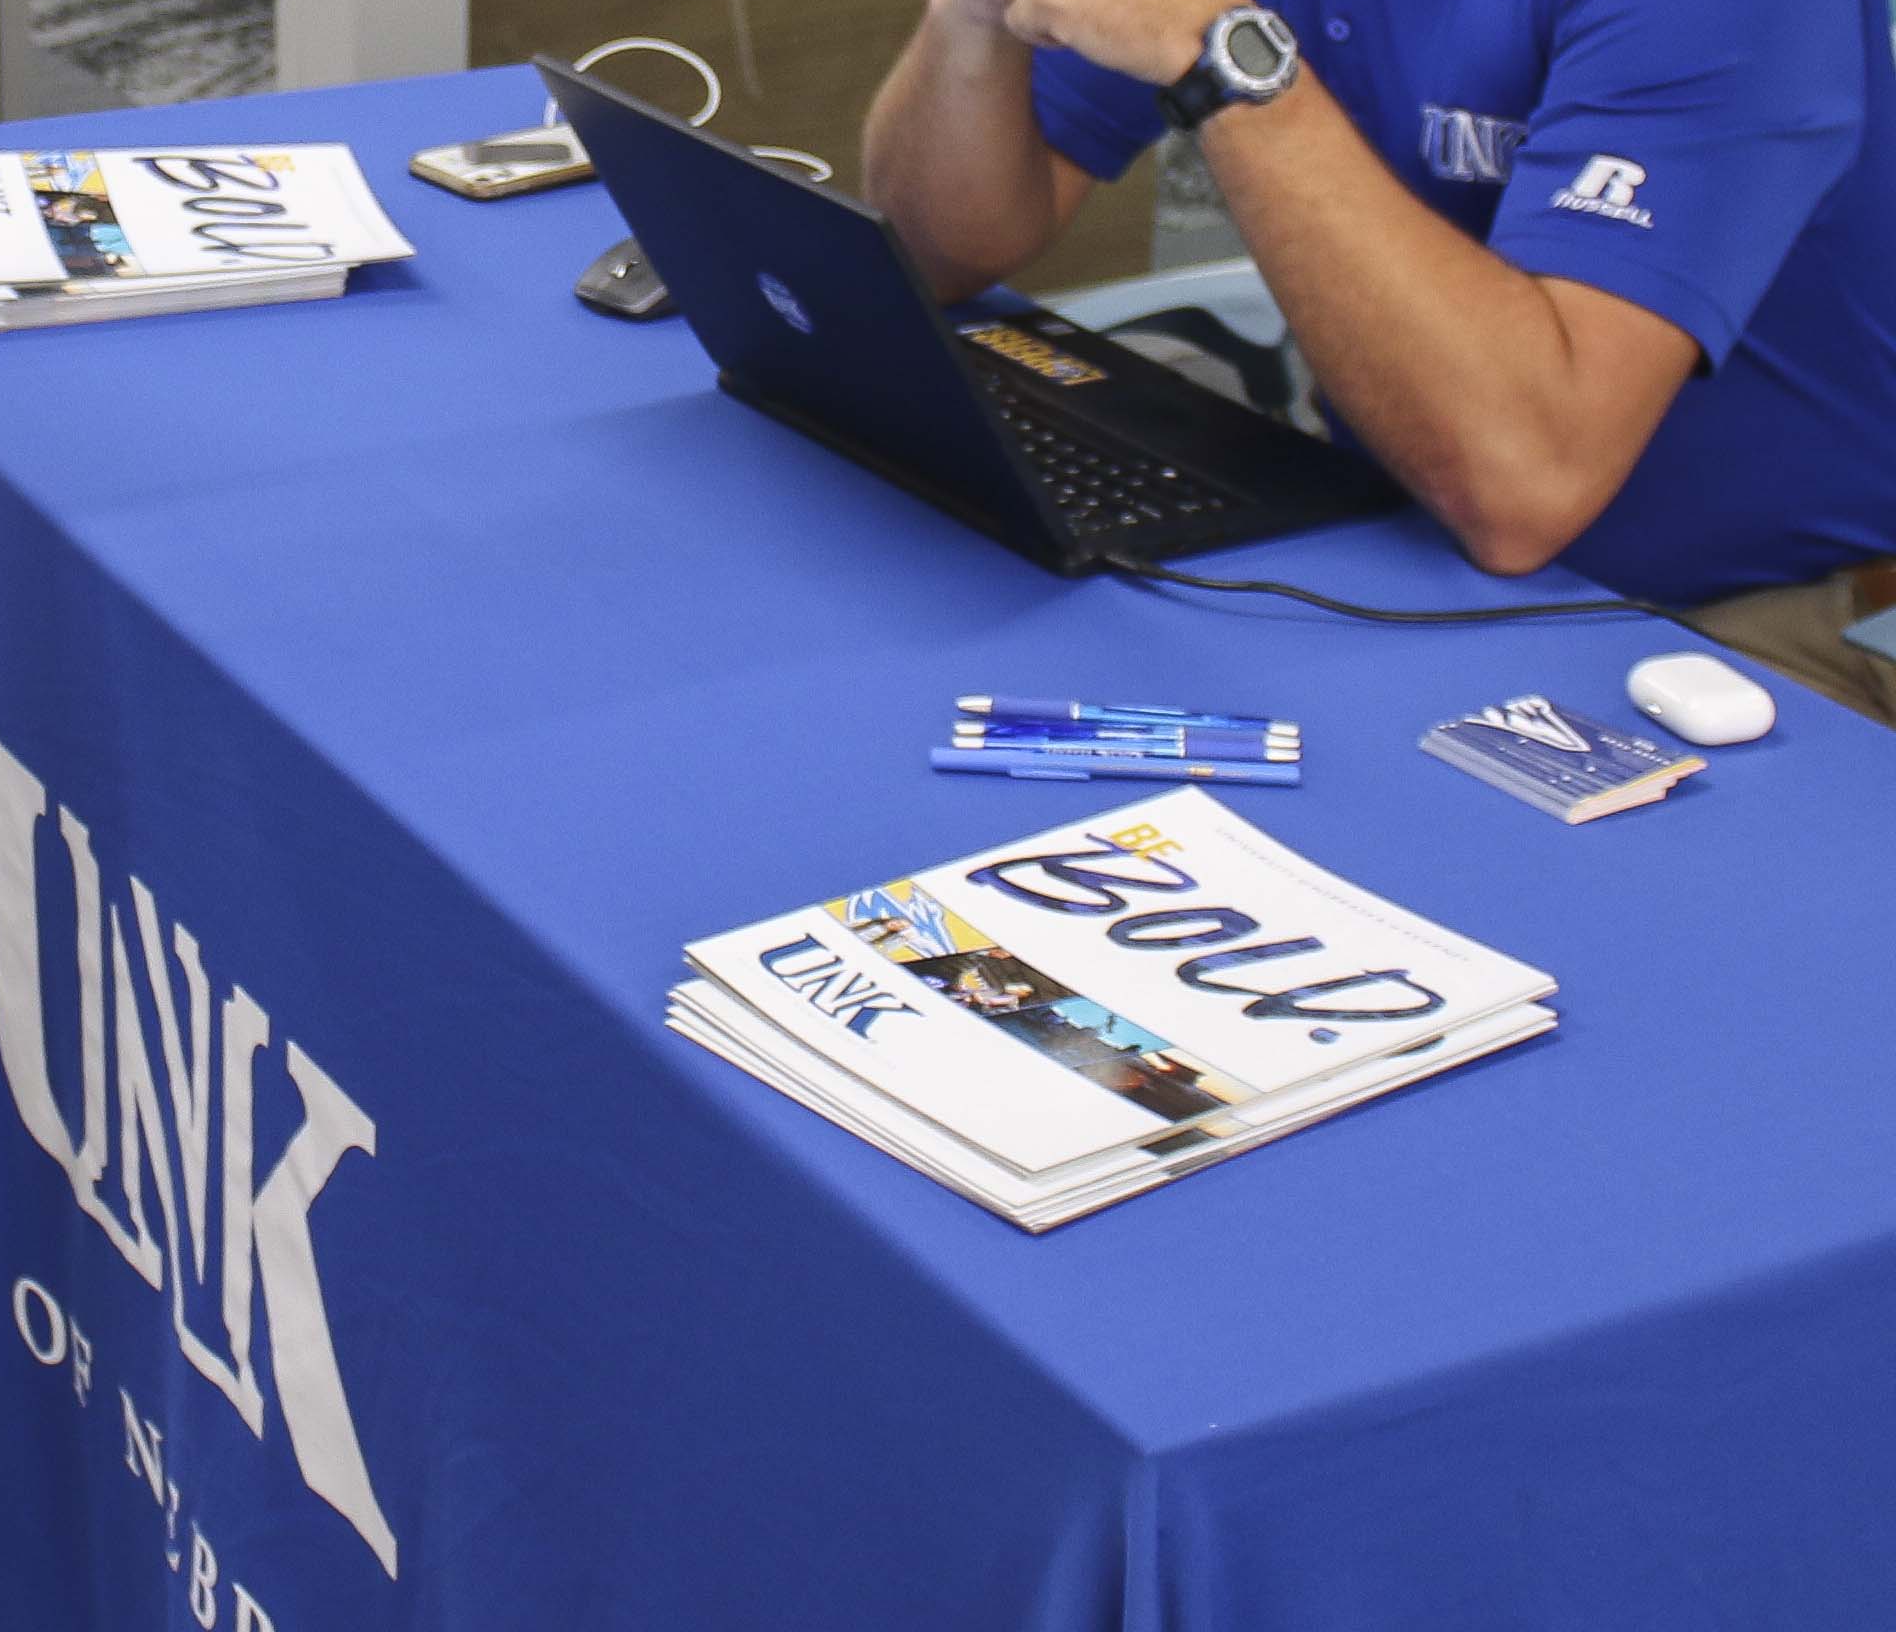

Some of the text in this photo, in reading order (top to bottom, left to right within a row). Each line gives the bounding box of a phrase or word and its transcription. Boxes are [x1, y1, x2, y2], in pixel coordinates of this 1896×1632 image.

[1571, 153, 1647, 207] R
[1110, 822, 1186, 860] BE
[758, 931, 932, 1045] UNK
